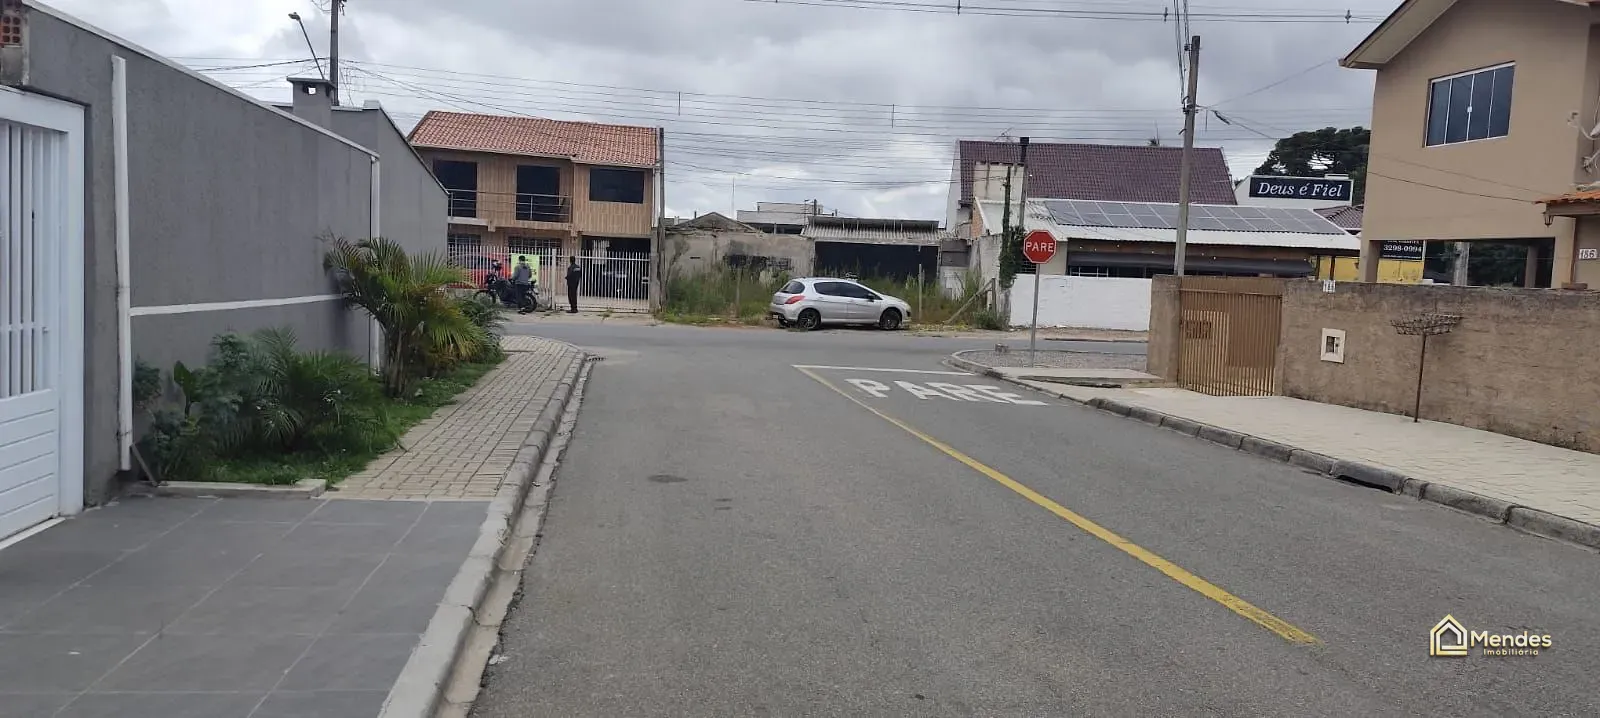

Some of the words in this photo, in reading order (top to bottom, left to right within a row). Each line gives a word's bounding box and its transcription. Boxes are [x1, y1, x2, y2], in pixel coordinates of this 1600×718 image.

[1258, 182, 1295, 195] Deus
[1299, 183, 1310, 196] é
[1311, 183, 1343, 197] Fiel
[1025, 241, 1055, 253] PARE
[844, 378, 1048, 406] PARE
